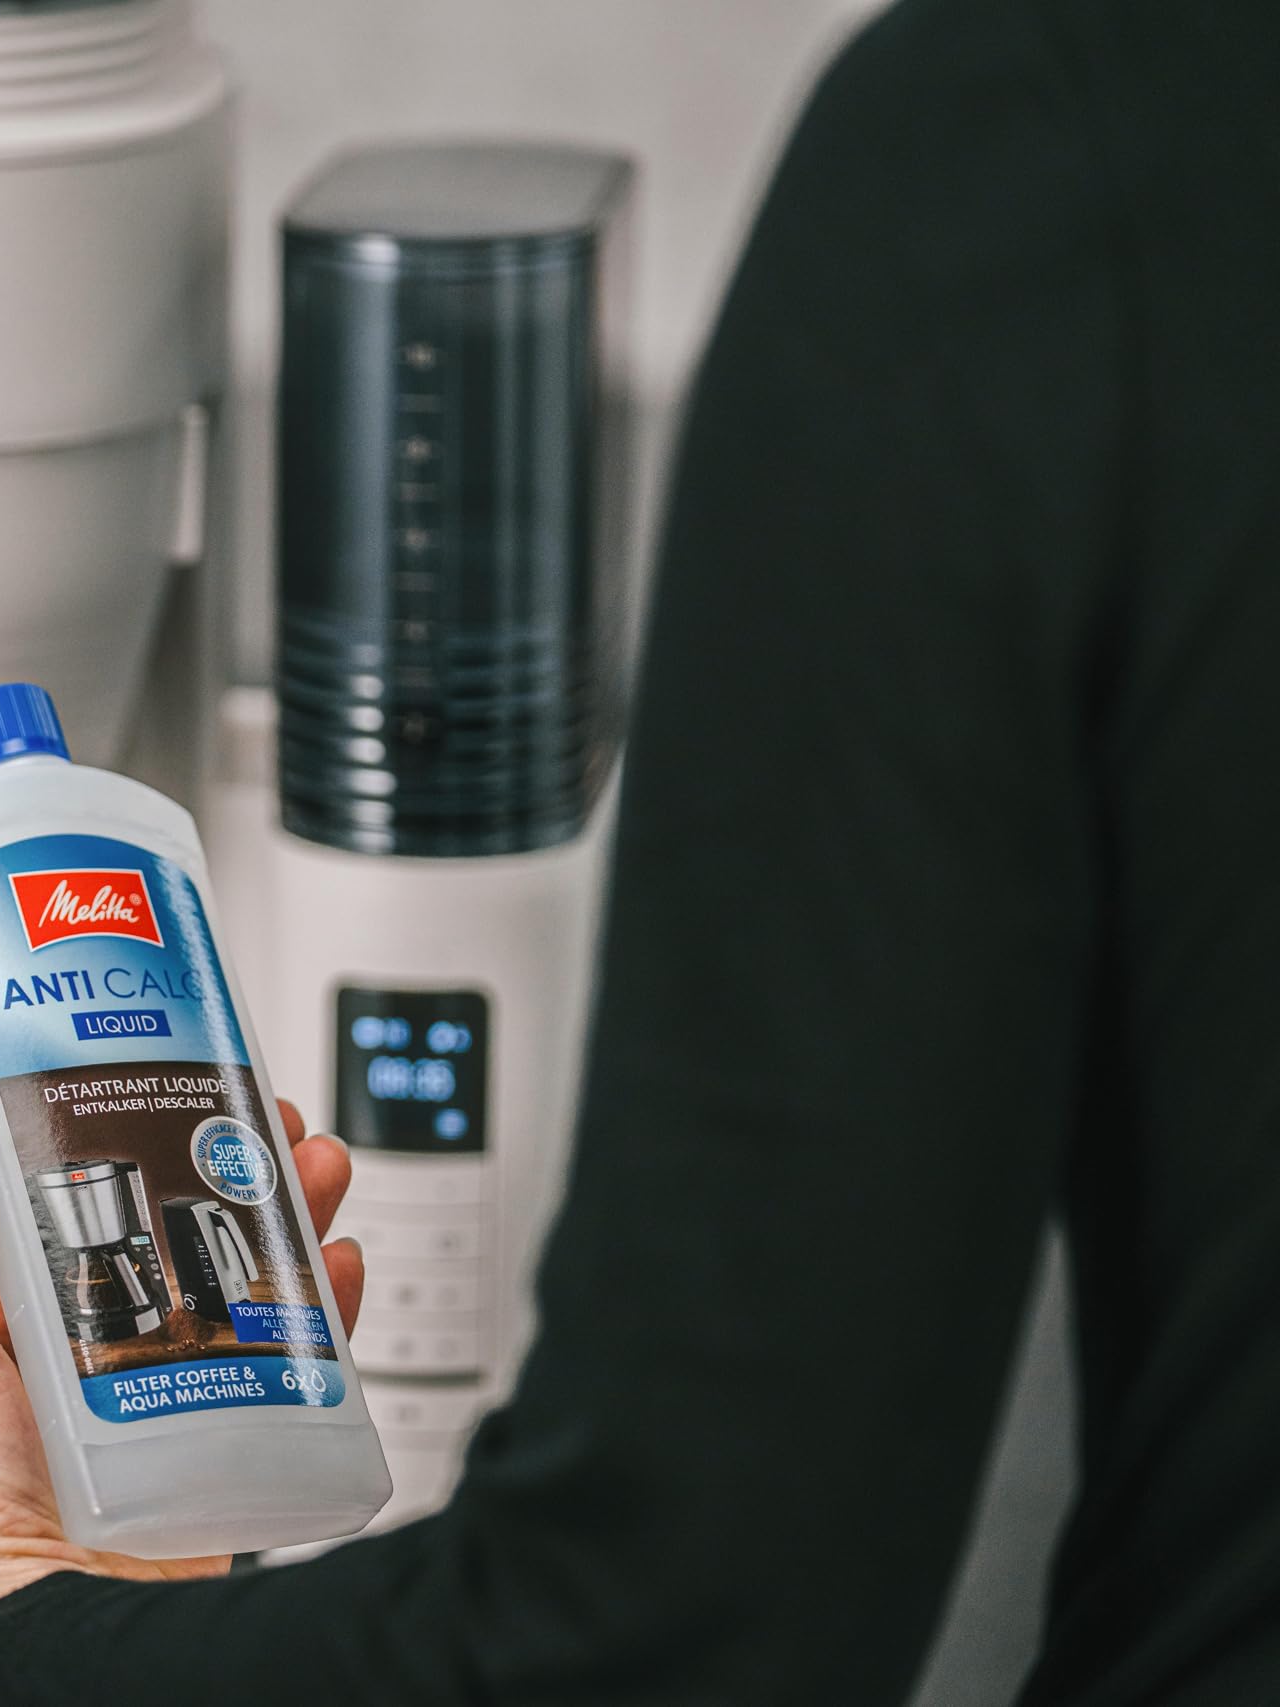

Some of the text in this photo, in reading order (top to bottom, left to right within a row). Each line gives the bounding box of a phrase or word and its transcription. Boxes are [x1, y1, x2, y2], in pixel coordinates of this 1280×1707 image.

[3, 970, 95, 1010] ANTI
[85, 1015, 158, 1035] LIQUID
[43, 1076, 230, 1103] DÉTARTRANT LIQUIDE
[73, 1097, 147, 1116] ENTKALKER
[155, 1096, 216, 1110] DESCALER
[213, 1143, 253, 1161] SUPER
[236, 1306, 274, 1317] TOUTES
[262, 1318, 285, 1328] ALLE
[272, 1330, 289, 1340] ALL
[113, 1366, 257, 1396] FILTER COFFEE &
[120, 1382, 265, 1414] AQUA MACHINES
